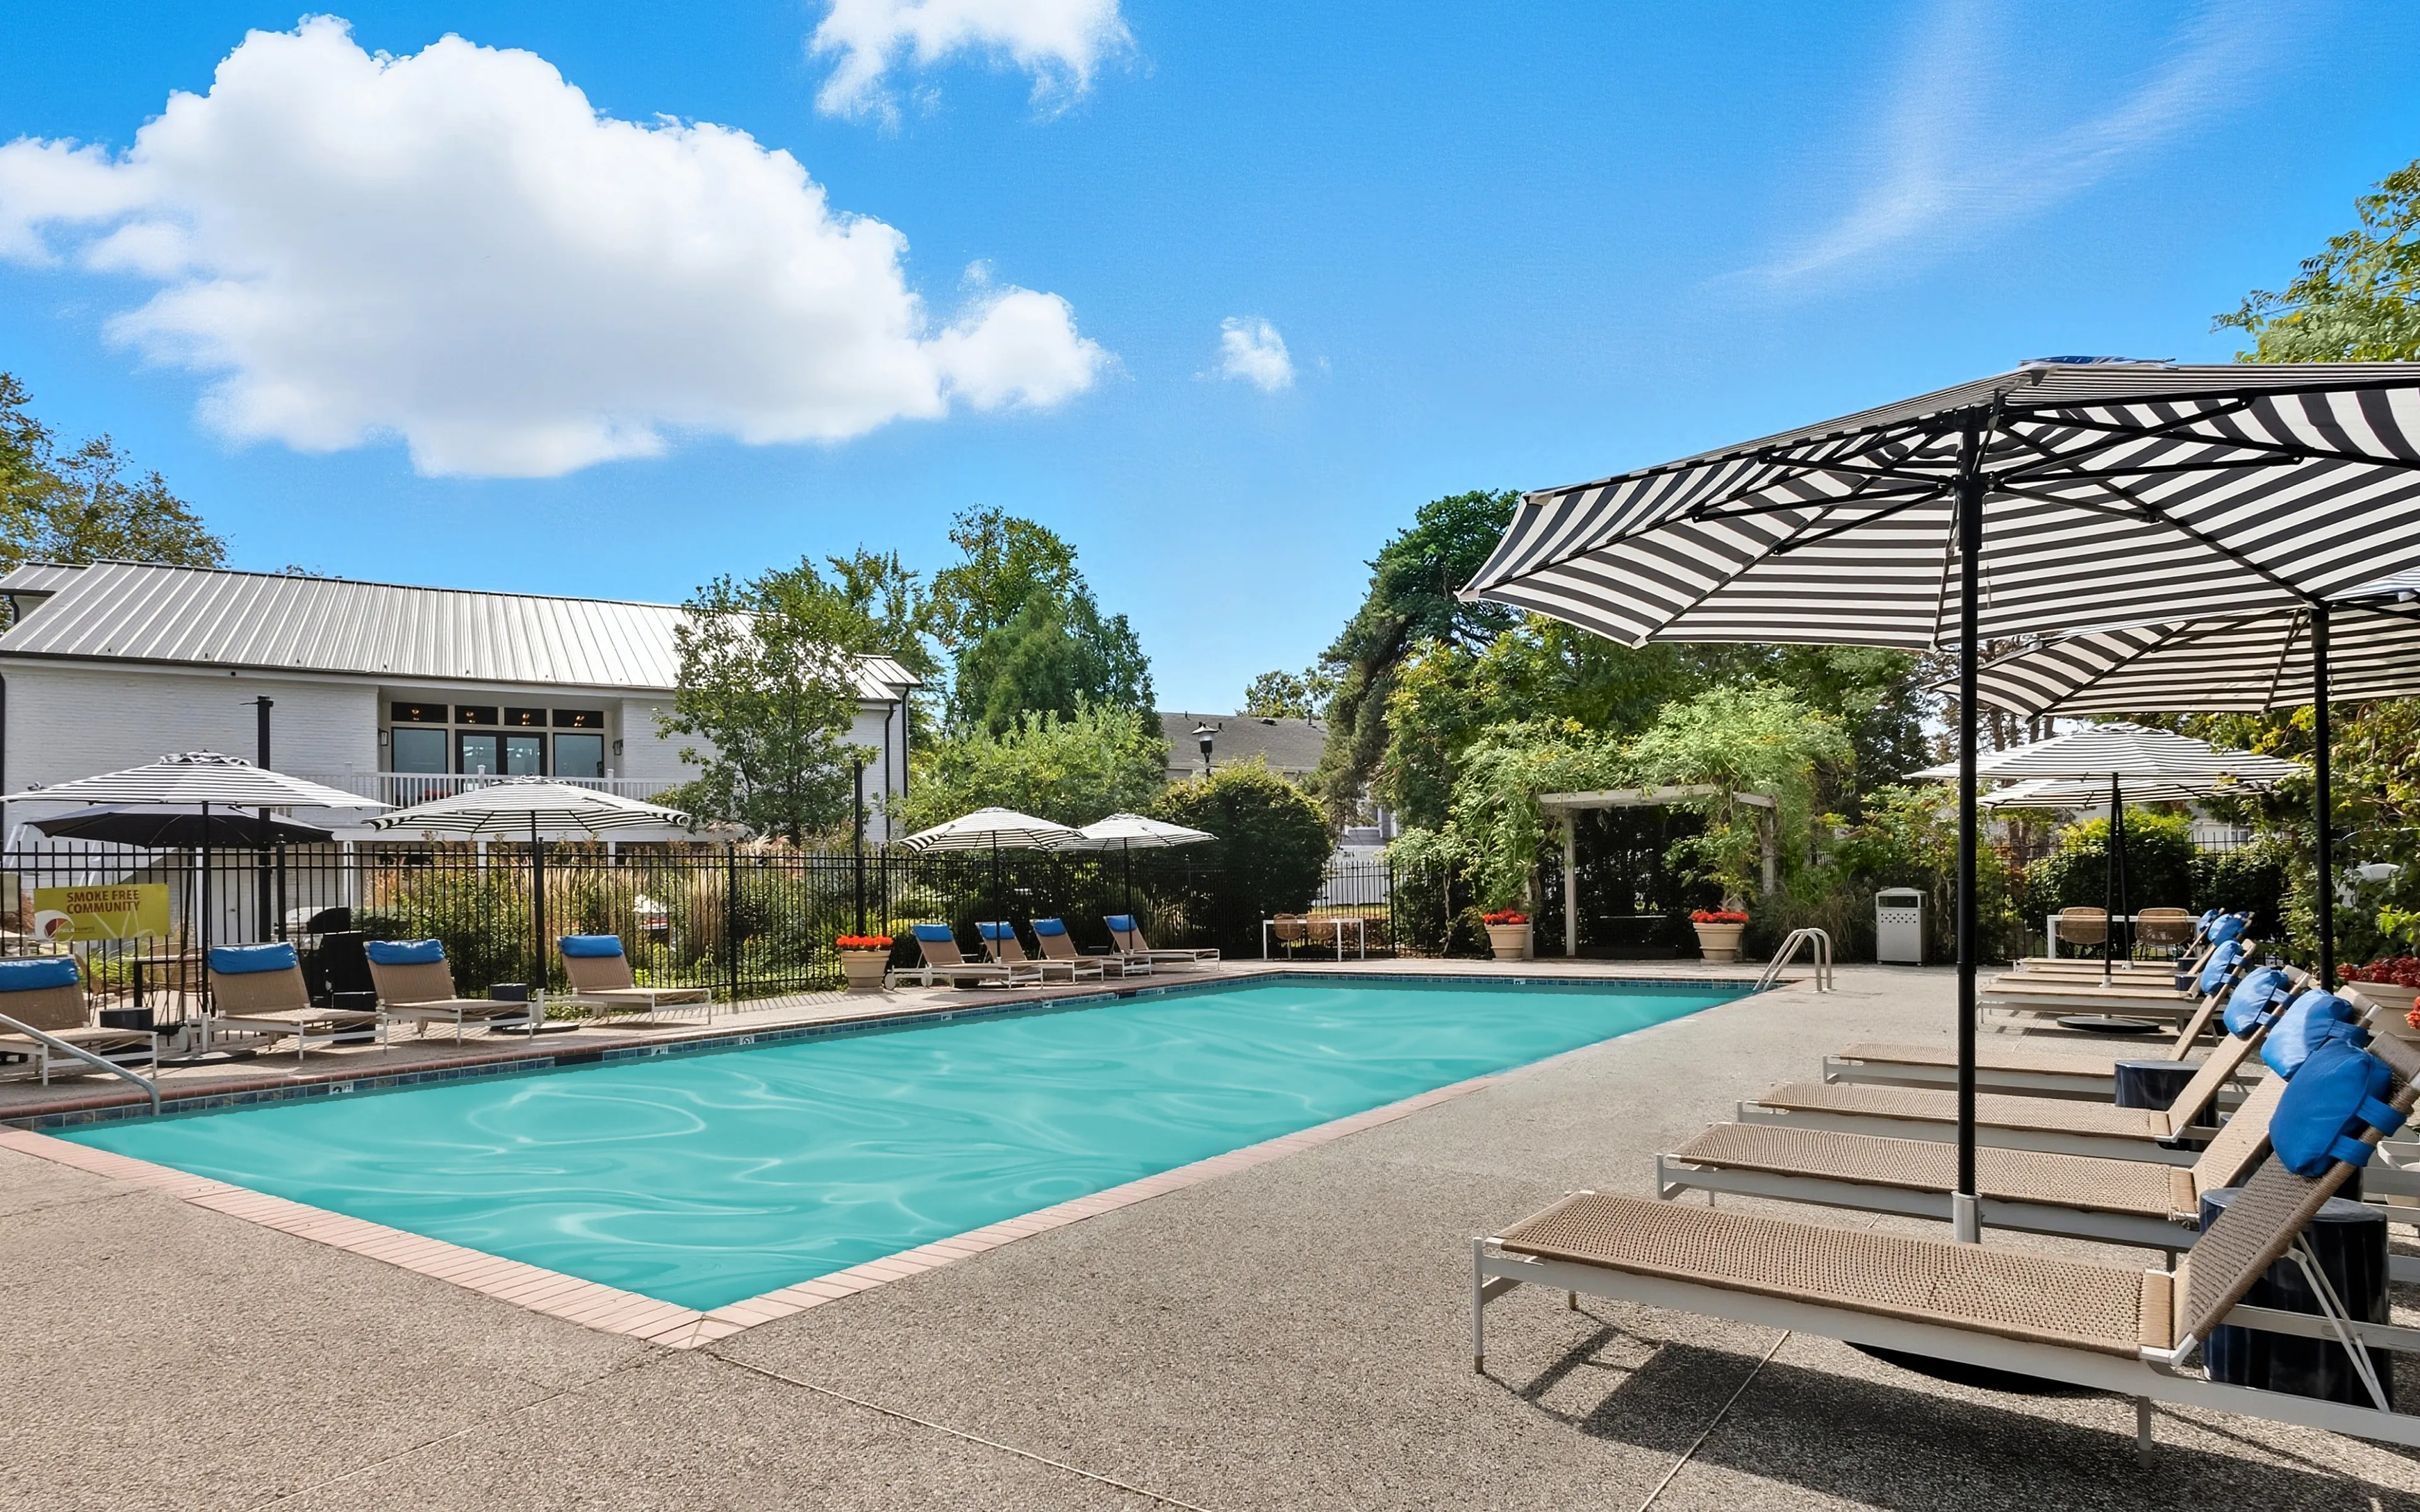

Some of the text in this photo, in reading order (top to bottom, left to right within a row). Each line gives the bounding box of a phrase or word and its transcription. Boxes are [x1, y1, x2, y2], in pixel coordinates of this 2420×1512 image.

[67, 890, 139, 903] SMOKE FREE
[66, 901, 140, 914] COMMUNITY
